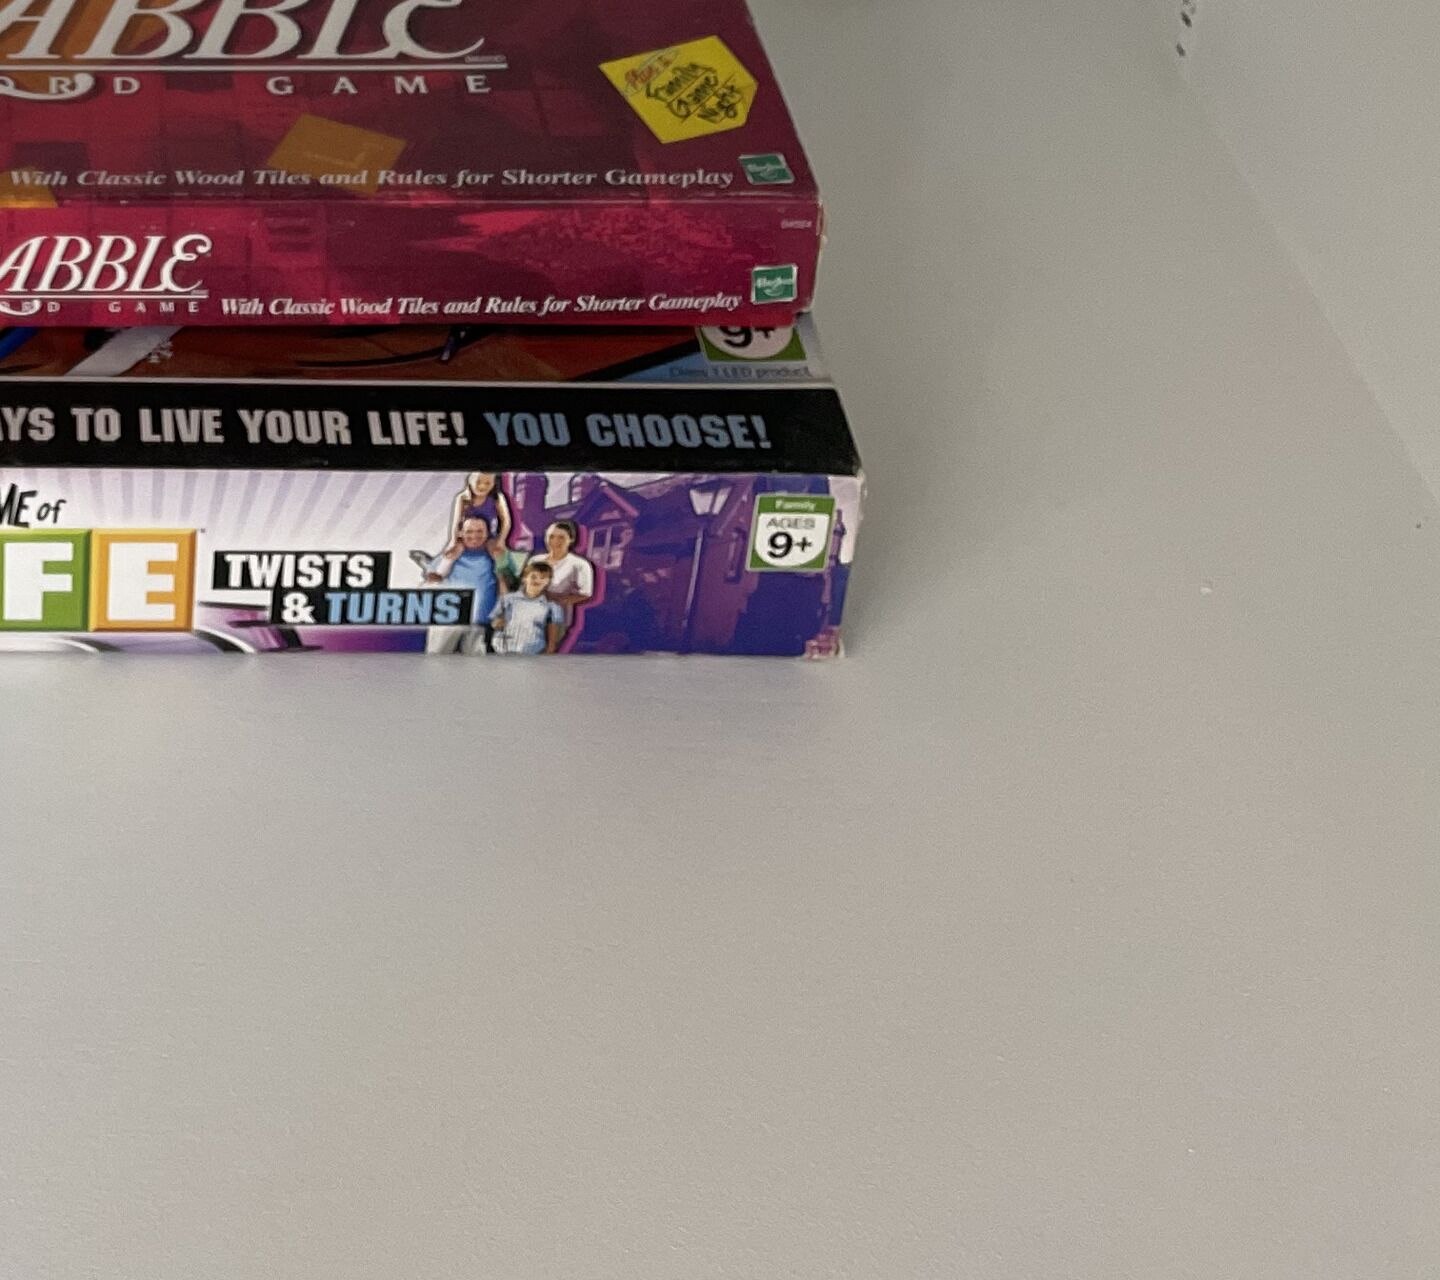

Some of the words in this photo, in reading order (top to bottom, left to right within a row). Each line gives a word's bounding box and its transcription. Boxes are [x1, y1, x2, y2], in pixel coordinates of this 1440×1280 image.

[266, 74, 492, 95] GAME
[10, 170, 68, 186] With
[77, 170, 164, 186] Classic
[174, 170, 244, 186] Wood
[254, 170, 311, 186] Tiles
[319, 170, 369, 185] and
[376, 169, 448, 186] Rules
[452, 169, 493, 189] for
[501, 168, 598, 186] Shorter
[604, 168, 734, 189] Gameplay
[108, 300, 200, 313] GAME
[221, 298, 263, 315] With
[268, 298, 335, 315] Classic
[340, 298, 393, 315] Wood
[398, 297, 439, 315] Tiles
[443, 296, 483, 314] and
[485, 296, 537, 314] Rules
[537, 295, 572, 316] for
[574, 294, 646, 312] Shorter
[648, 292, 742, 313] Gameplay
[71, 407, 122, 441] TO
[139, 408, 225, 443] LIVE
[238, 409, 352, 445] YOUR
[367, 410, 469, 446] LIFE!
[484, 412, 572, 446] YOU
[585, 413, 772, 449] CHOOSE!
[37, 499, 67, 523] of
[767, 531, 813, 559] 9+
[224, 553, 375, 588] TWISTS
[281, 592, 317, 624] &
[324, 593, 460, 624] TURNS
